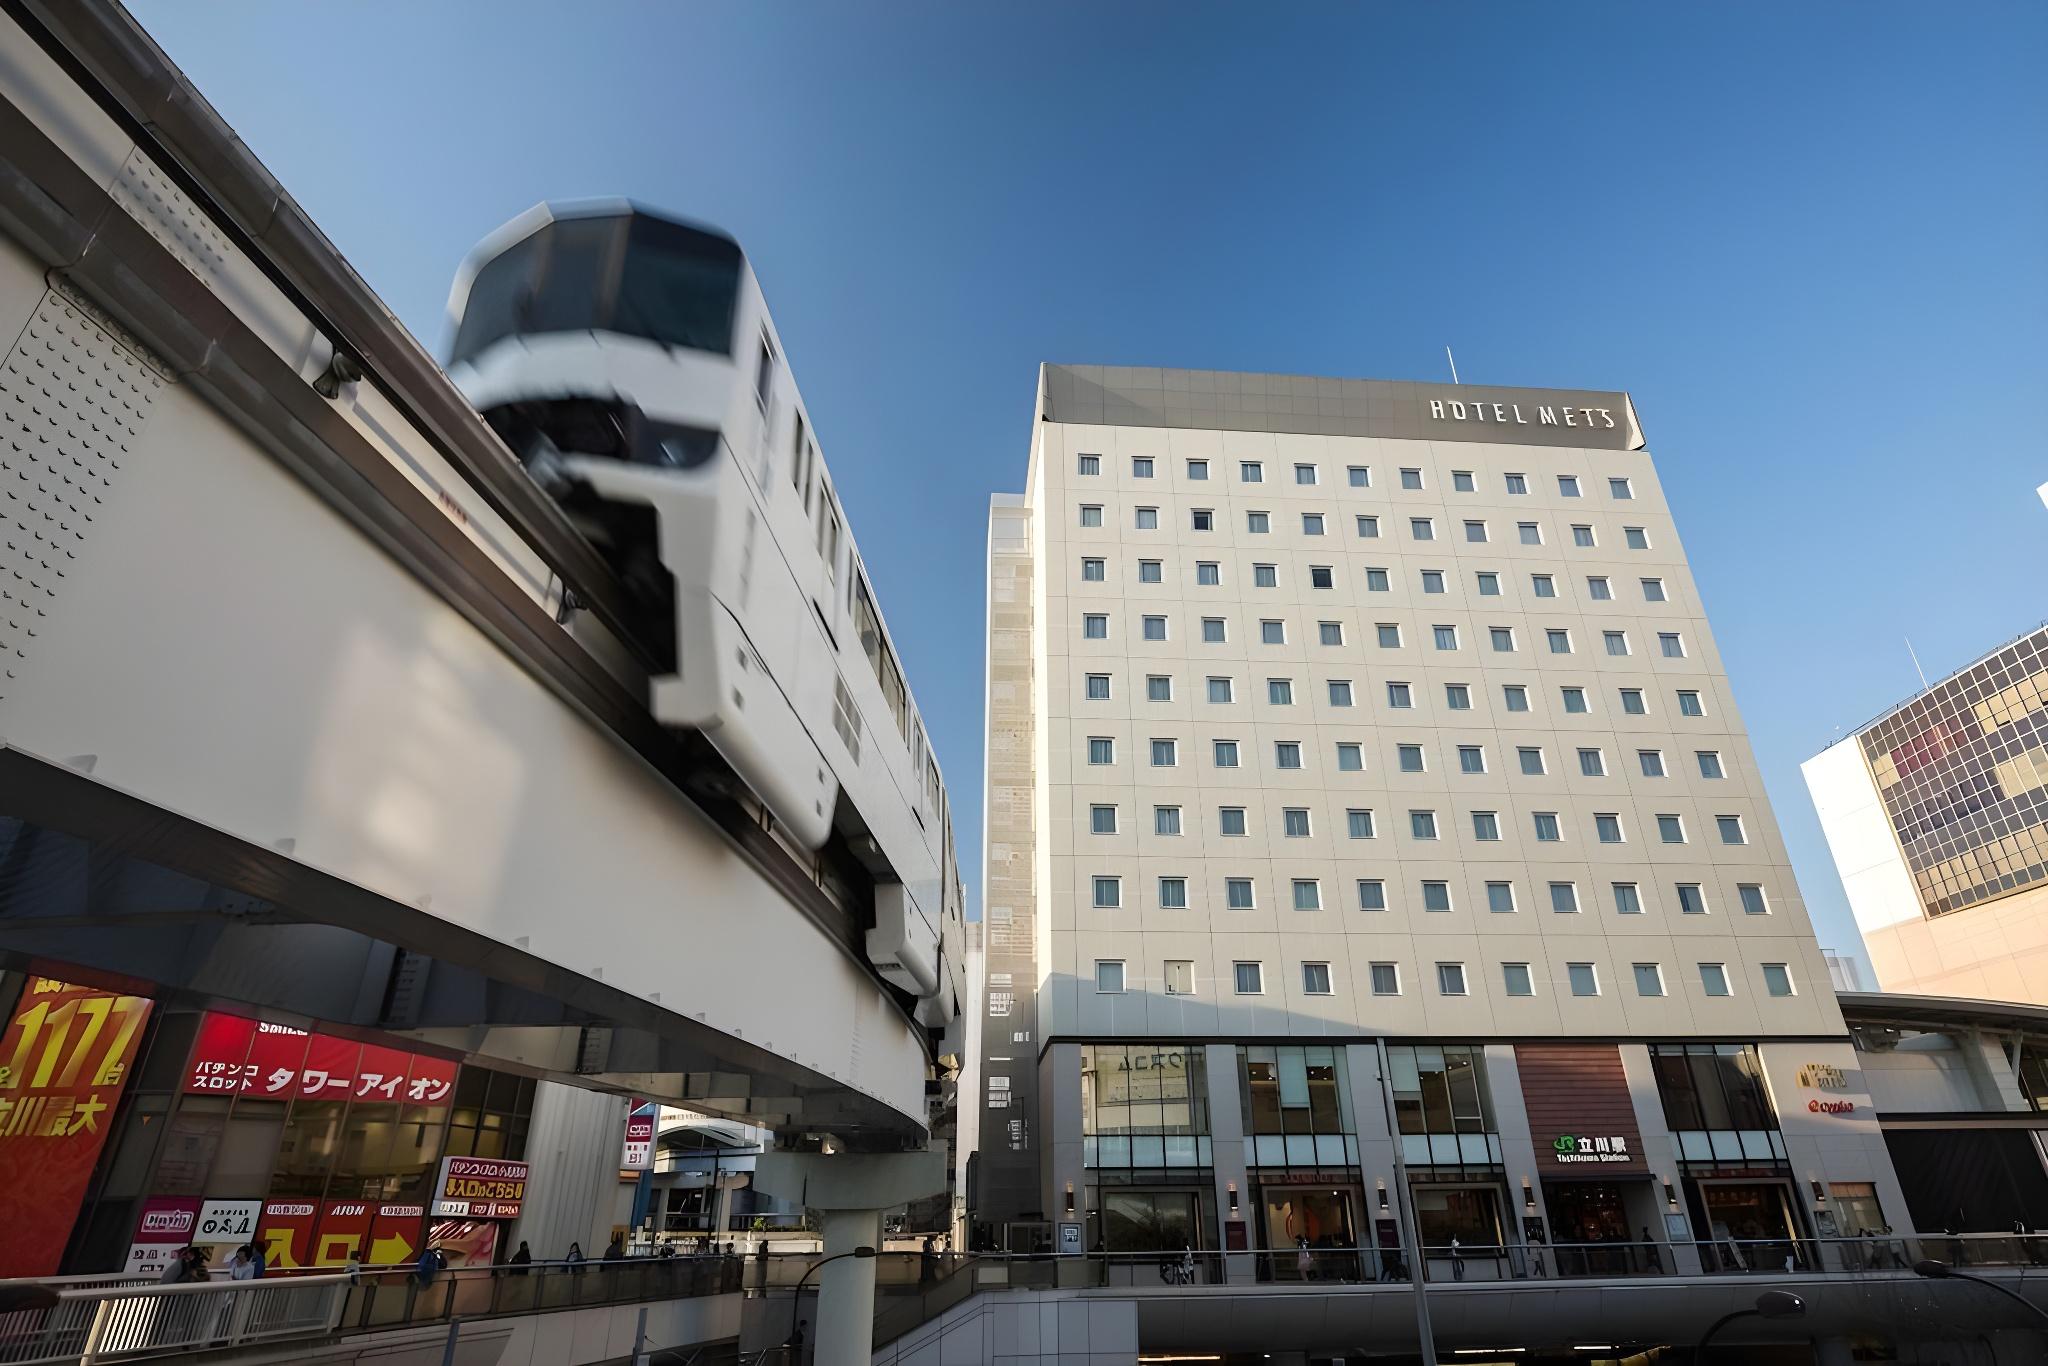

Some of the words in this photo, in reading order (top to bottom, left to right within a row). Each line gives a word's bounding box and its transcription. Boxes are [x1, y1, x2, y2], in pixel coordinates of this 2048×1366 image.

[1430, 400, 1527, 424] HOTEL
[1538, 406, 1615, 429] METS
[192, 1075, 252, 1091] スロット
[195, 1061, 258, 1077] パチンコ
[265, 1067, 450, 1101] タワーアイオン
[264, 1228, 361, 1268] 入口
